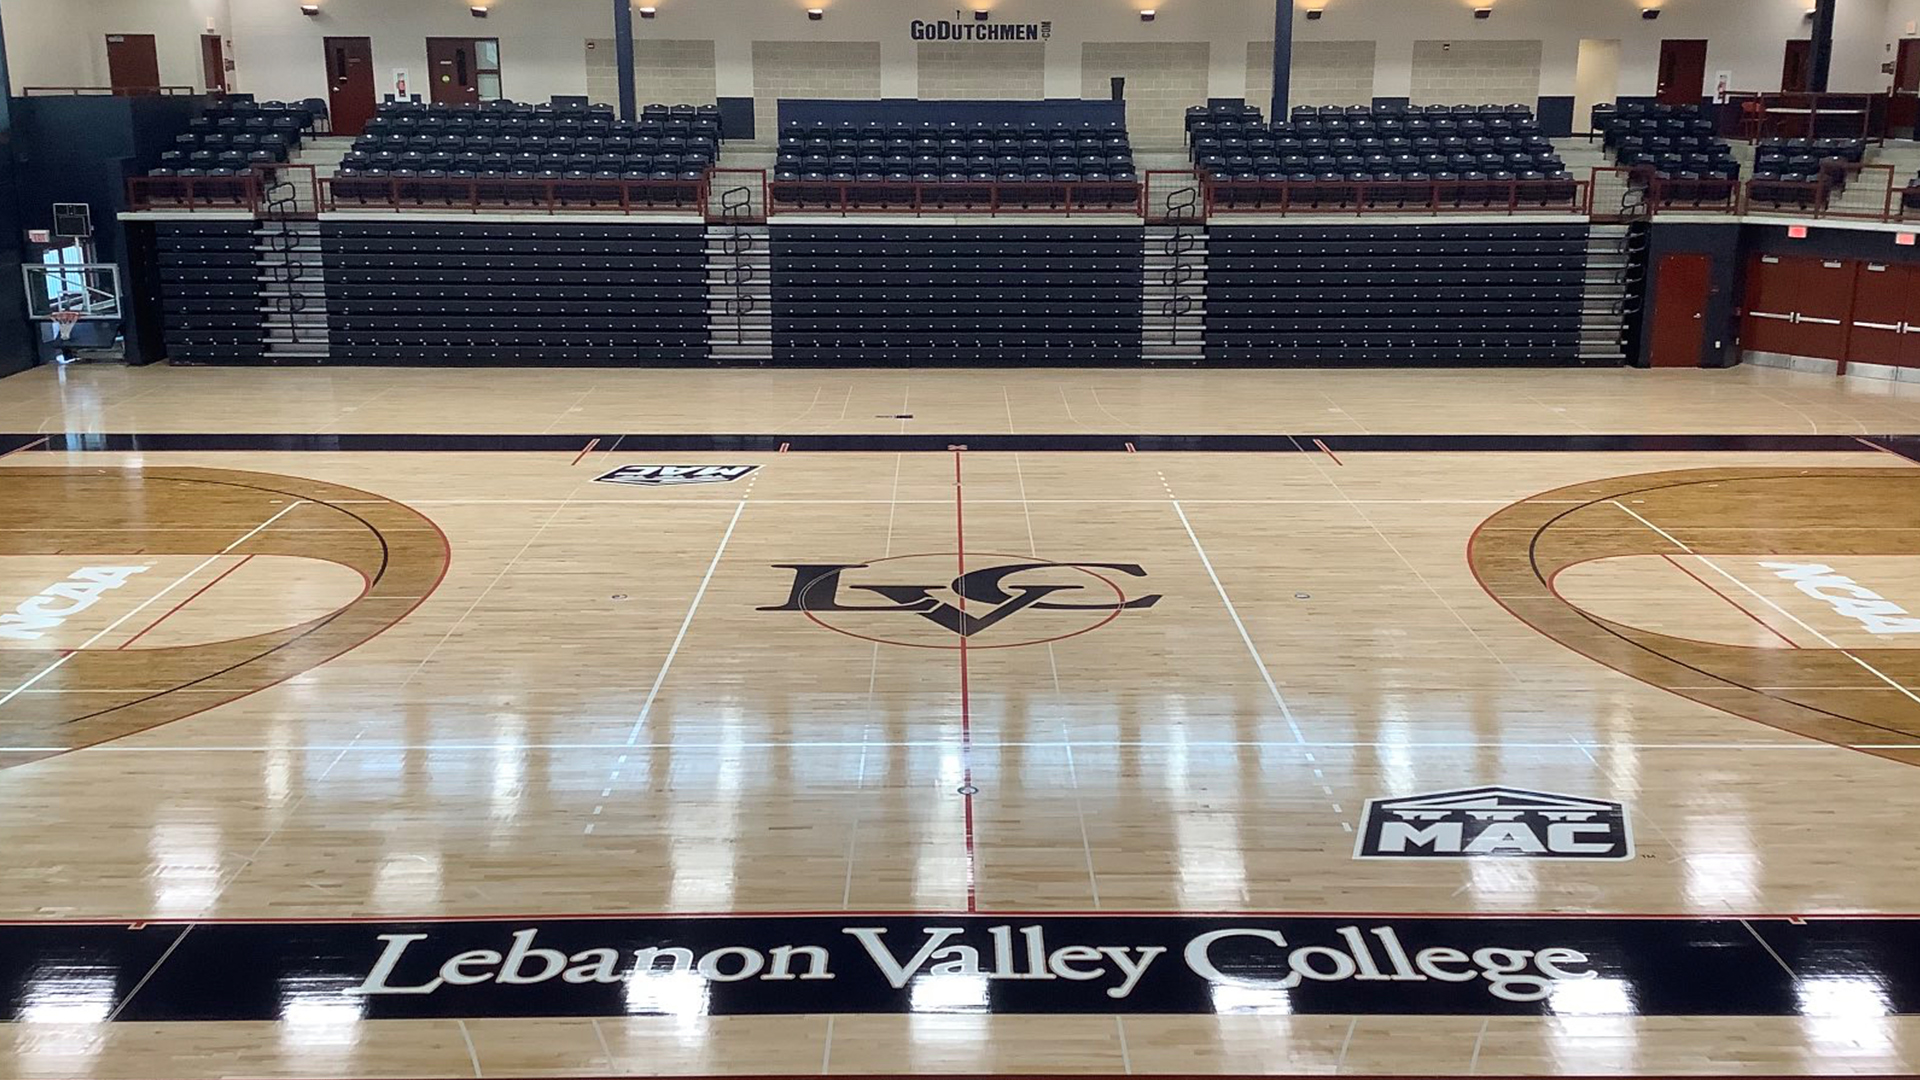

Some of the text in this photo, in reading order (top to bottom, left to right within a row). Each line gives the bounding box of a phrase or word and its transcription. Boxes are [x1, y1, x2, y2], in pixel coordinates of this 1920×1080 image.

[910, 20, 1038, 40] GODUTCHMEN
[613, 466, 750, 477] MAC
[0, 566, 151, 640] NCAA
[1757, 562, 1920, 634] NCAA
[1377, 822, 1615, 853] MAC
[343, 925, 1598, 1002] Lebanon Valley College
